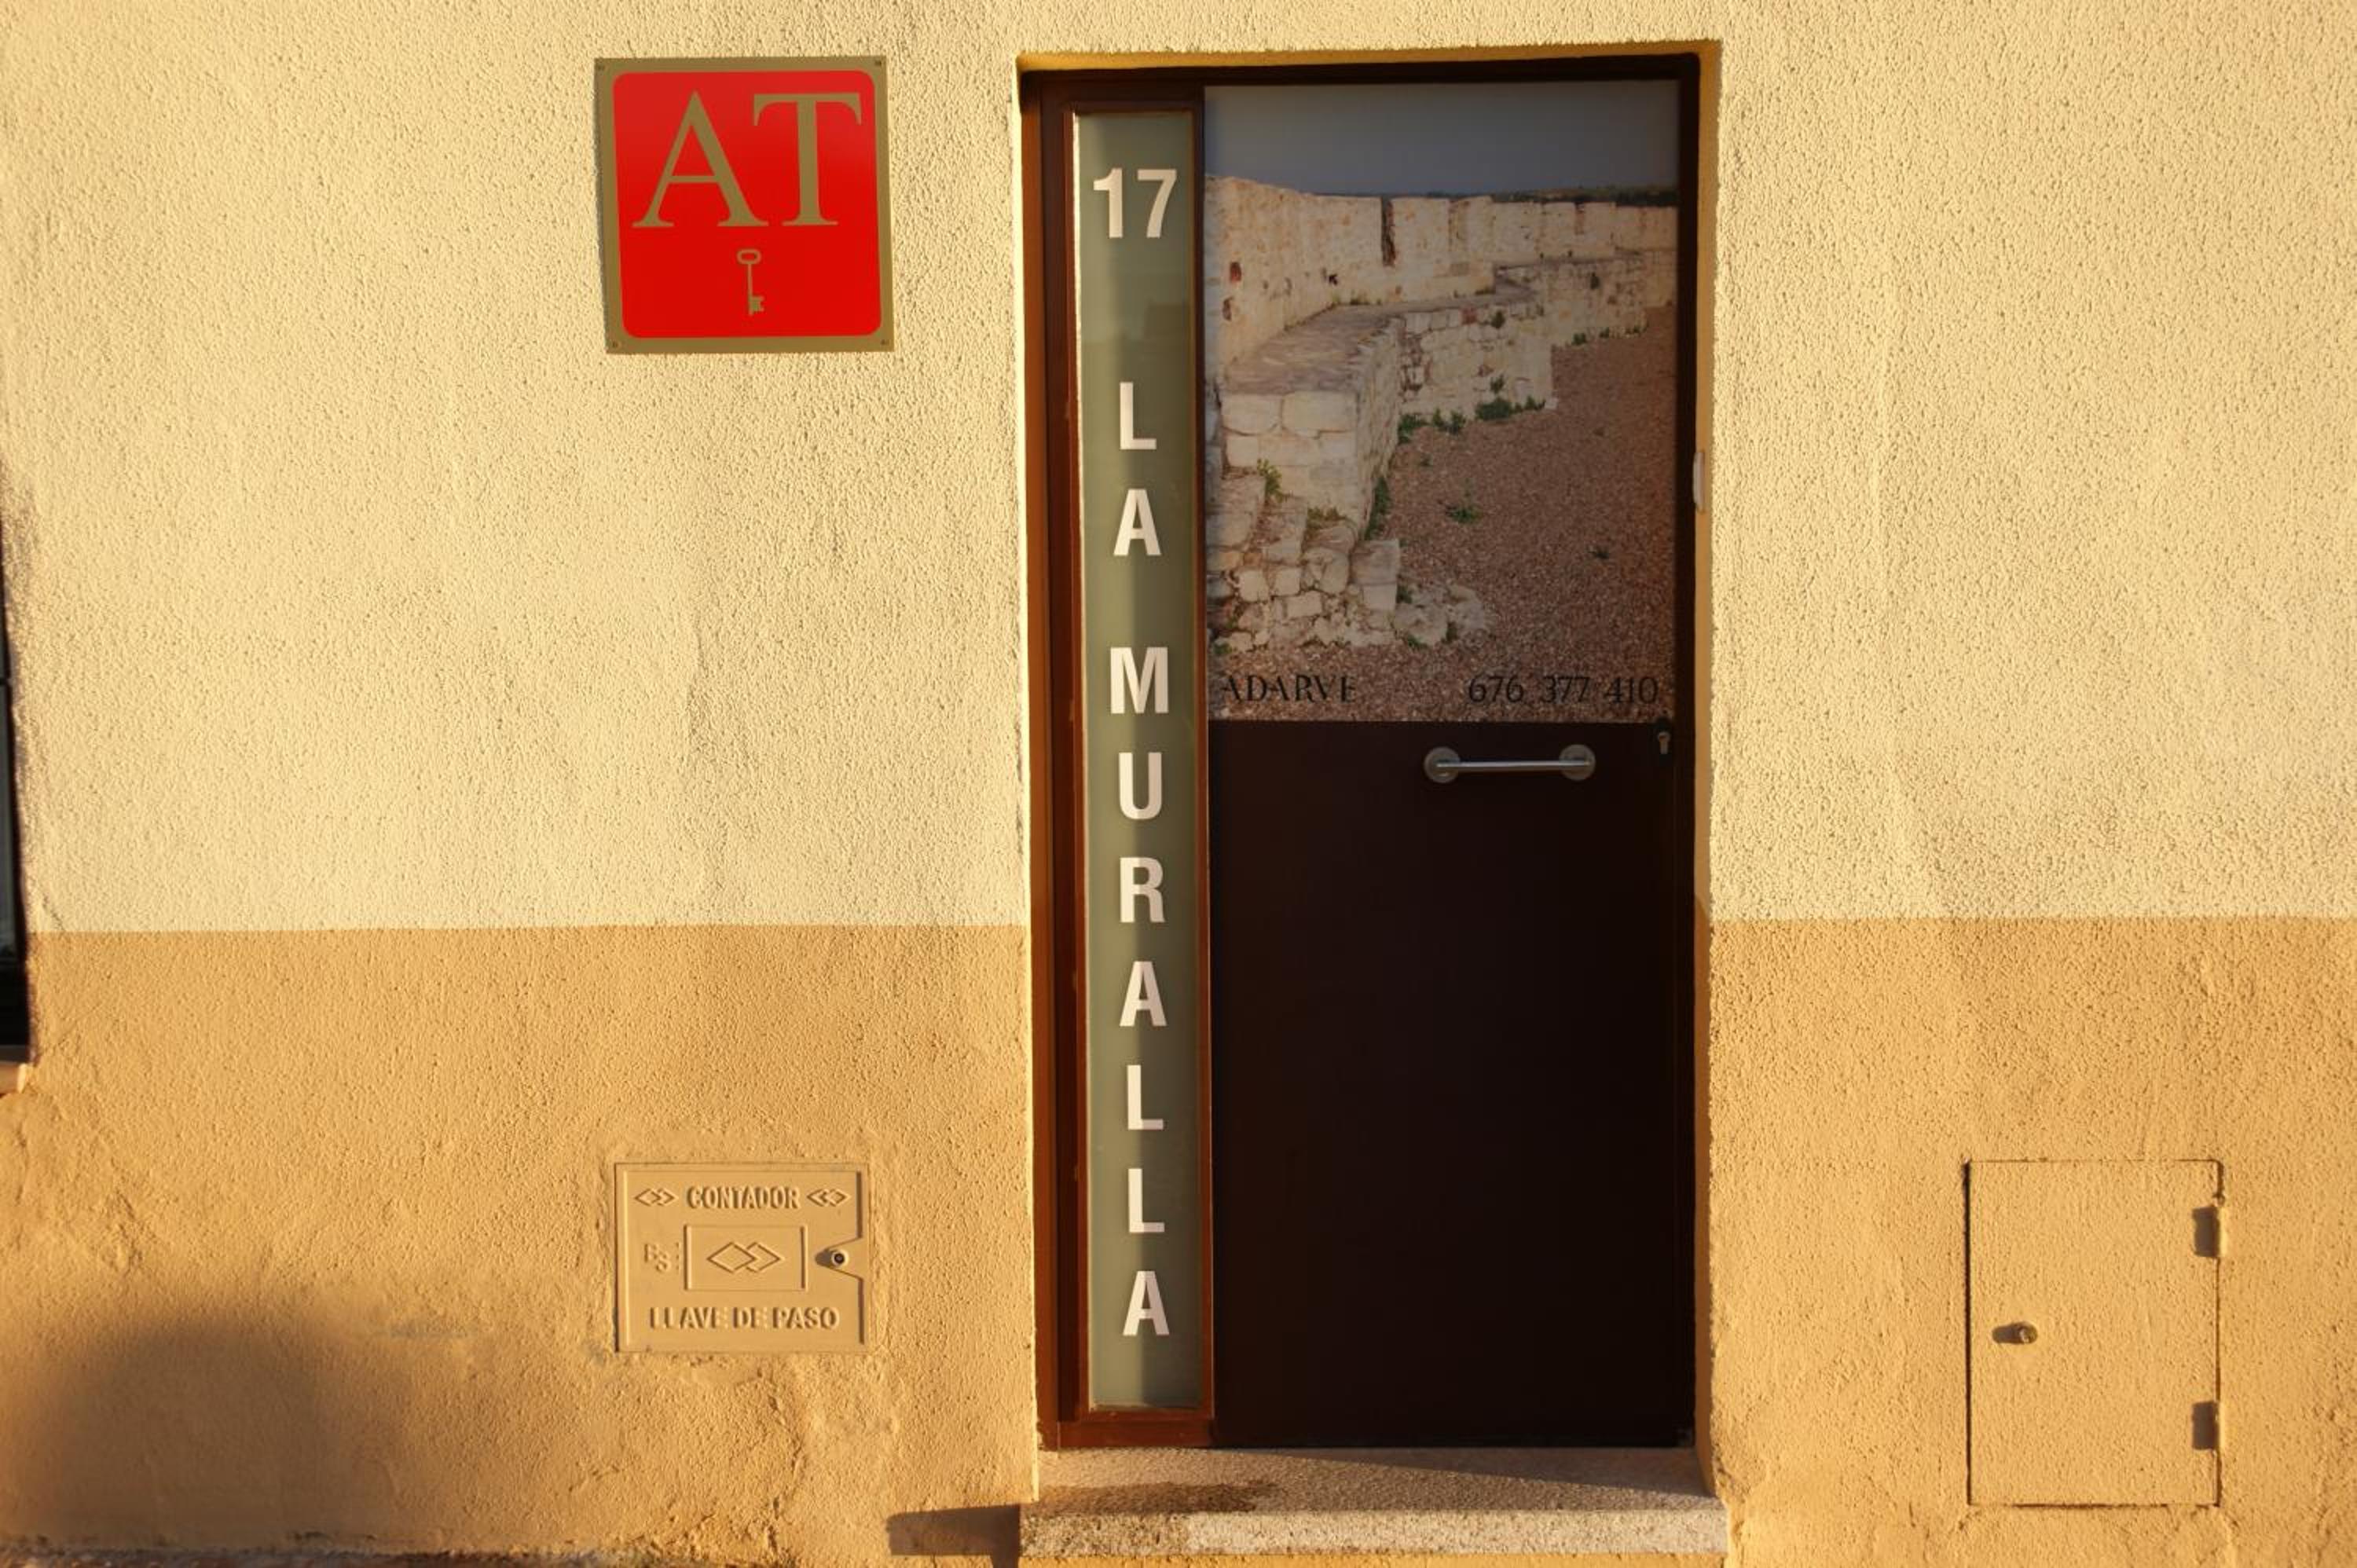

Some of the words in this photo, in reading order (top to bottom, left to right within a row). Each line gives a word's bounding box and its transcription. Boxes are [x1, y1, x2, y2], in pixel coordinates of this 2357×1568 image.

[632, 90, 862, 227] AT
[1093, 167, 1177, 238] 17
[1113, 382, 1161, 556] LA
[1219, 674, 1357, 703] ADARVE
[1468, 674, 1525, 703] 676
[1541, 675, 1591, 704] 377
[1603, 676, 1659, 704] 410
[1109, 647, 1171, 1336] MURALLA
[686, 1185, 801, 1210] CONTADOR
[649, 1306, 728, 1329] LLAVE
[732, 1306, 768, 1329] DE
[772, 1306, 841, 1329] PASO
